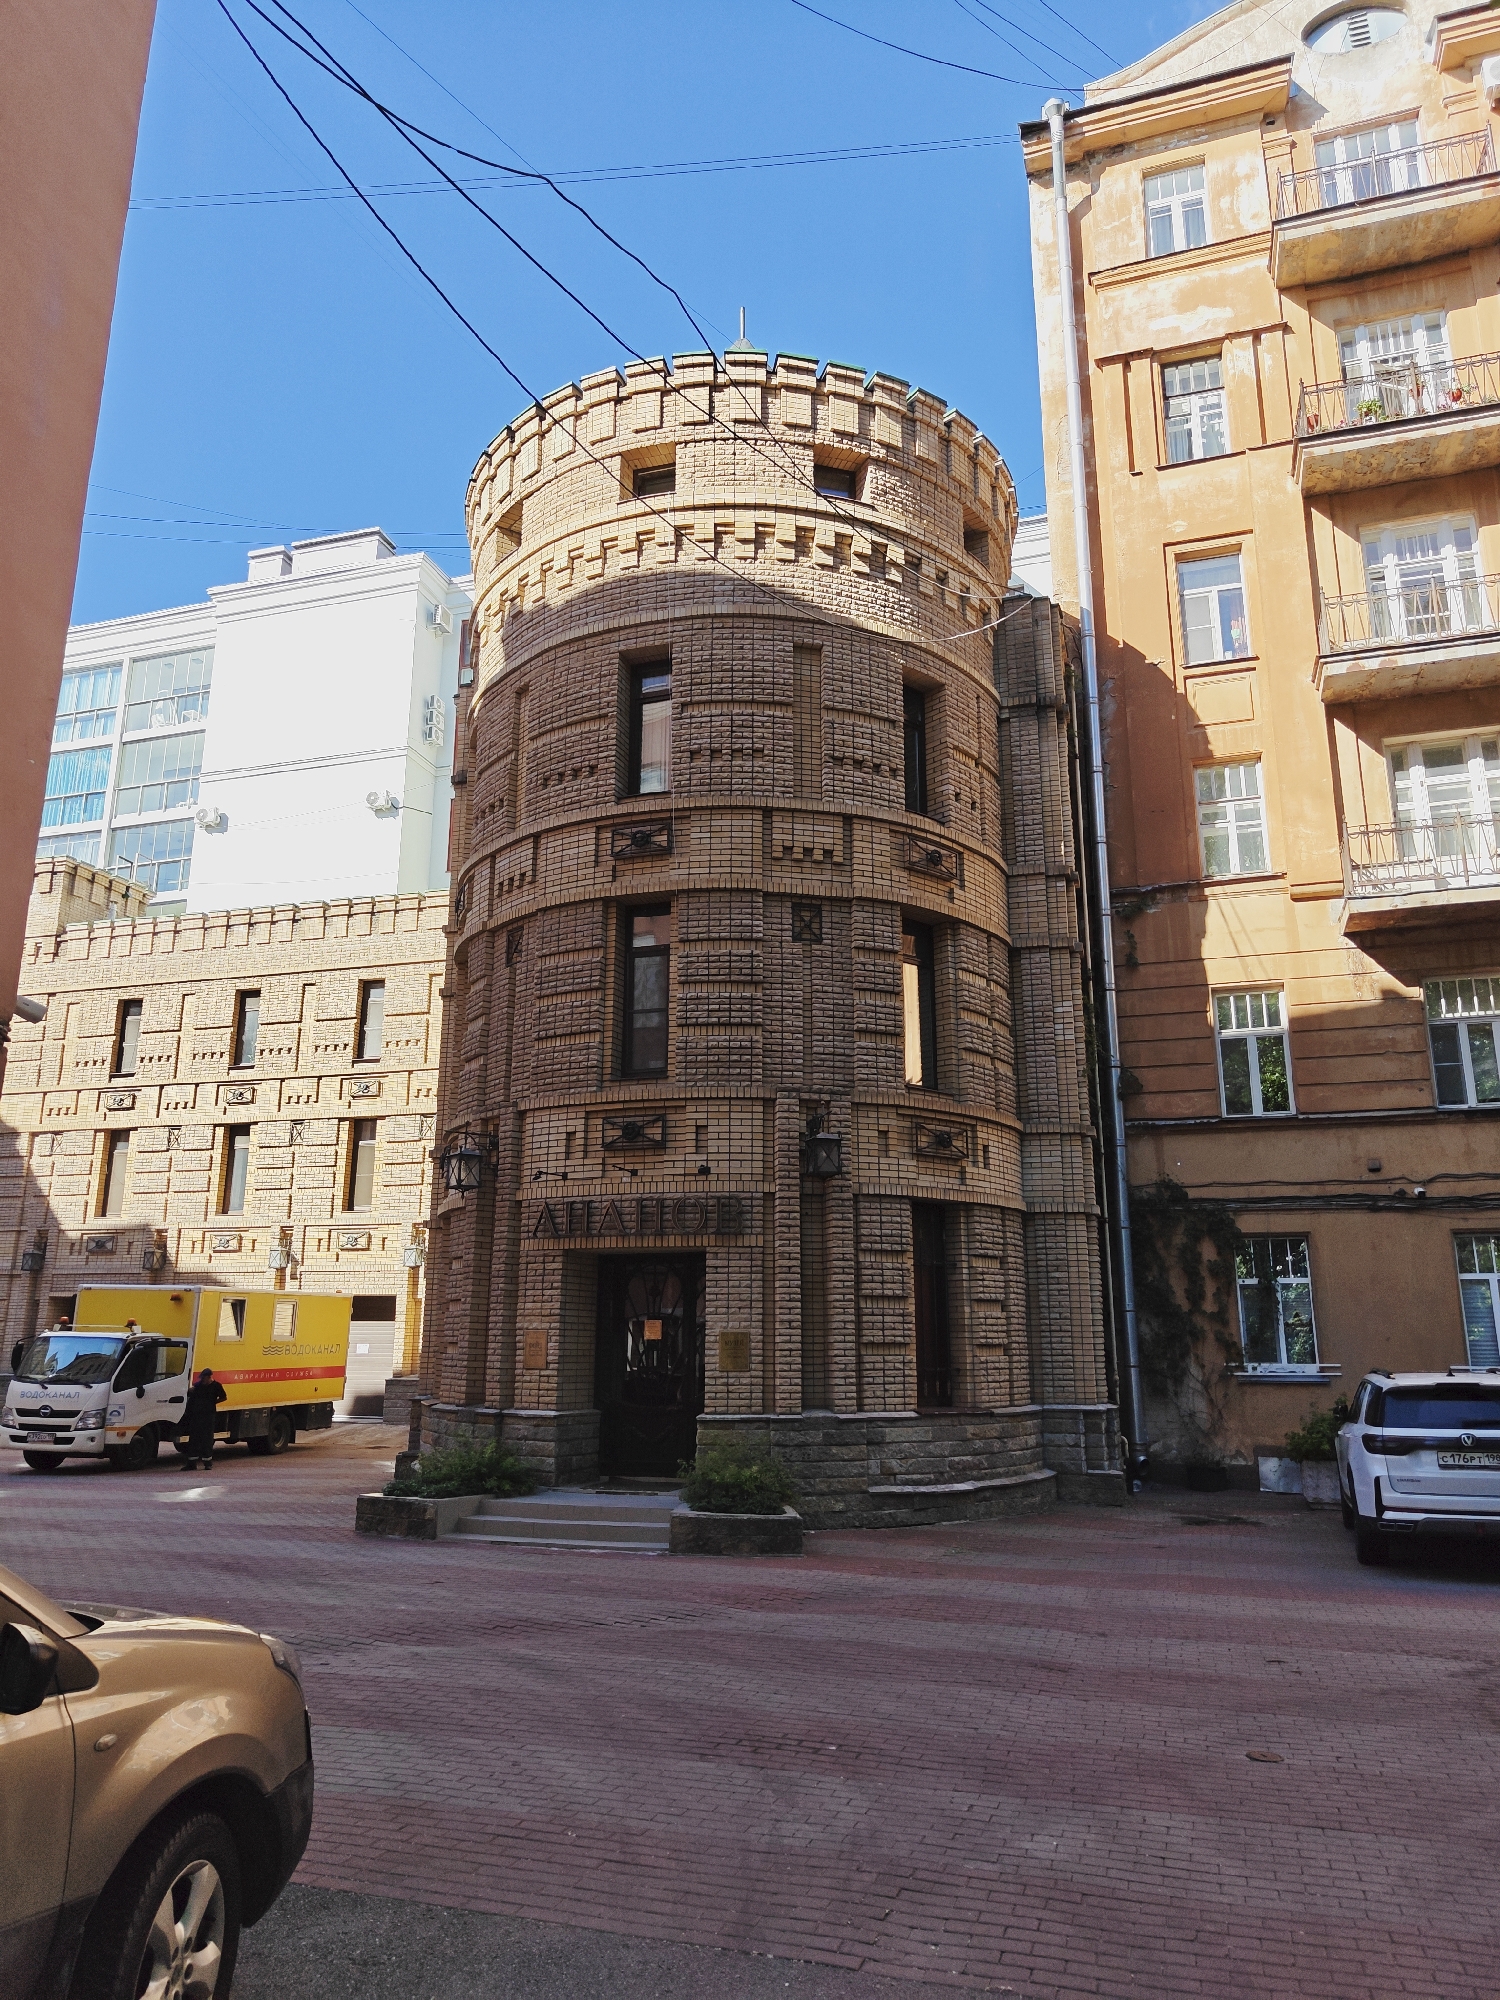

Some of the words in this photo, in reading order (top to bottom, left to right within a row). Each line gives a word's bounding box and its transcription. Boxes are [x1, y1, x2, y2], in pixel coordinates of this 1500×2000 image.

[531, 1196, 744, 1239] АНАНОВ
[284, 1343, 341, 1356] ВОДОКАНАЛ
[20, 1390, 80, 1399] ВОДОКАНАЛ
